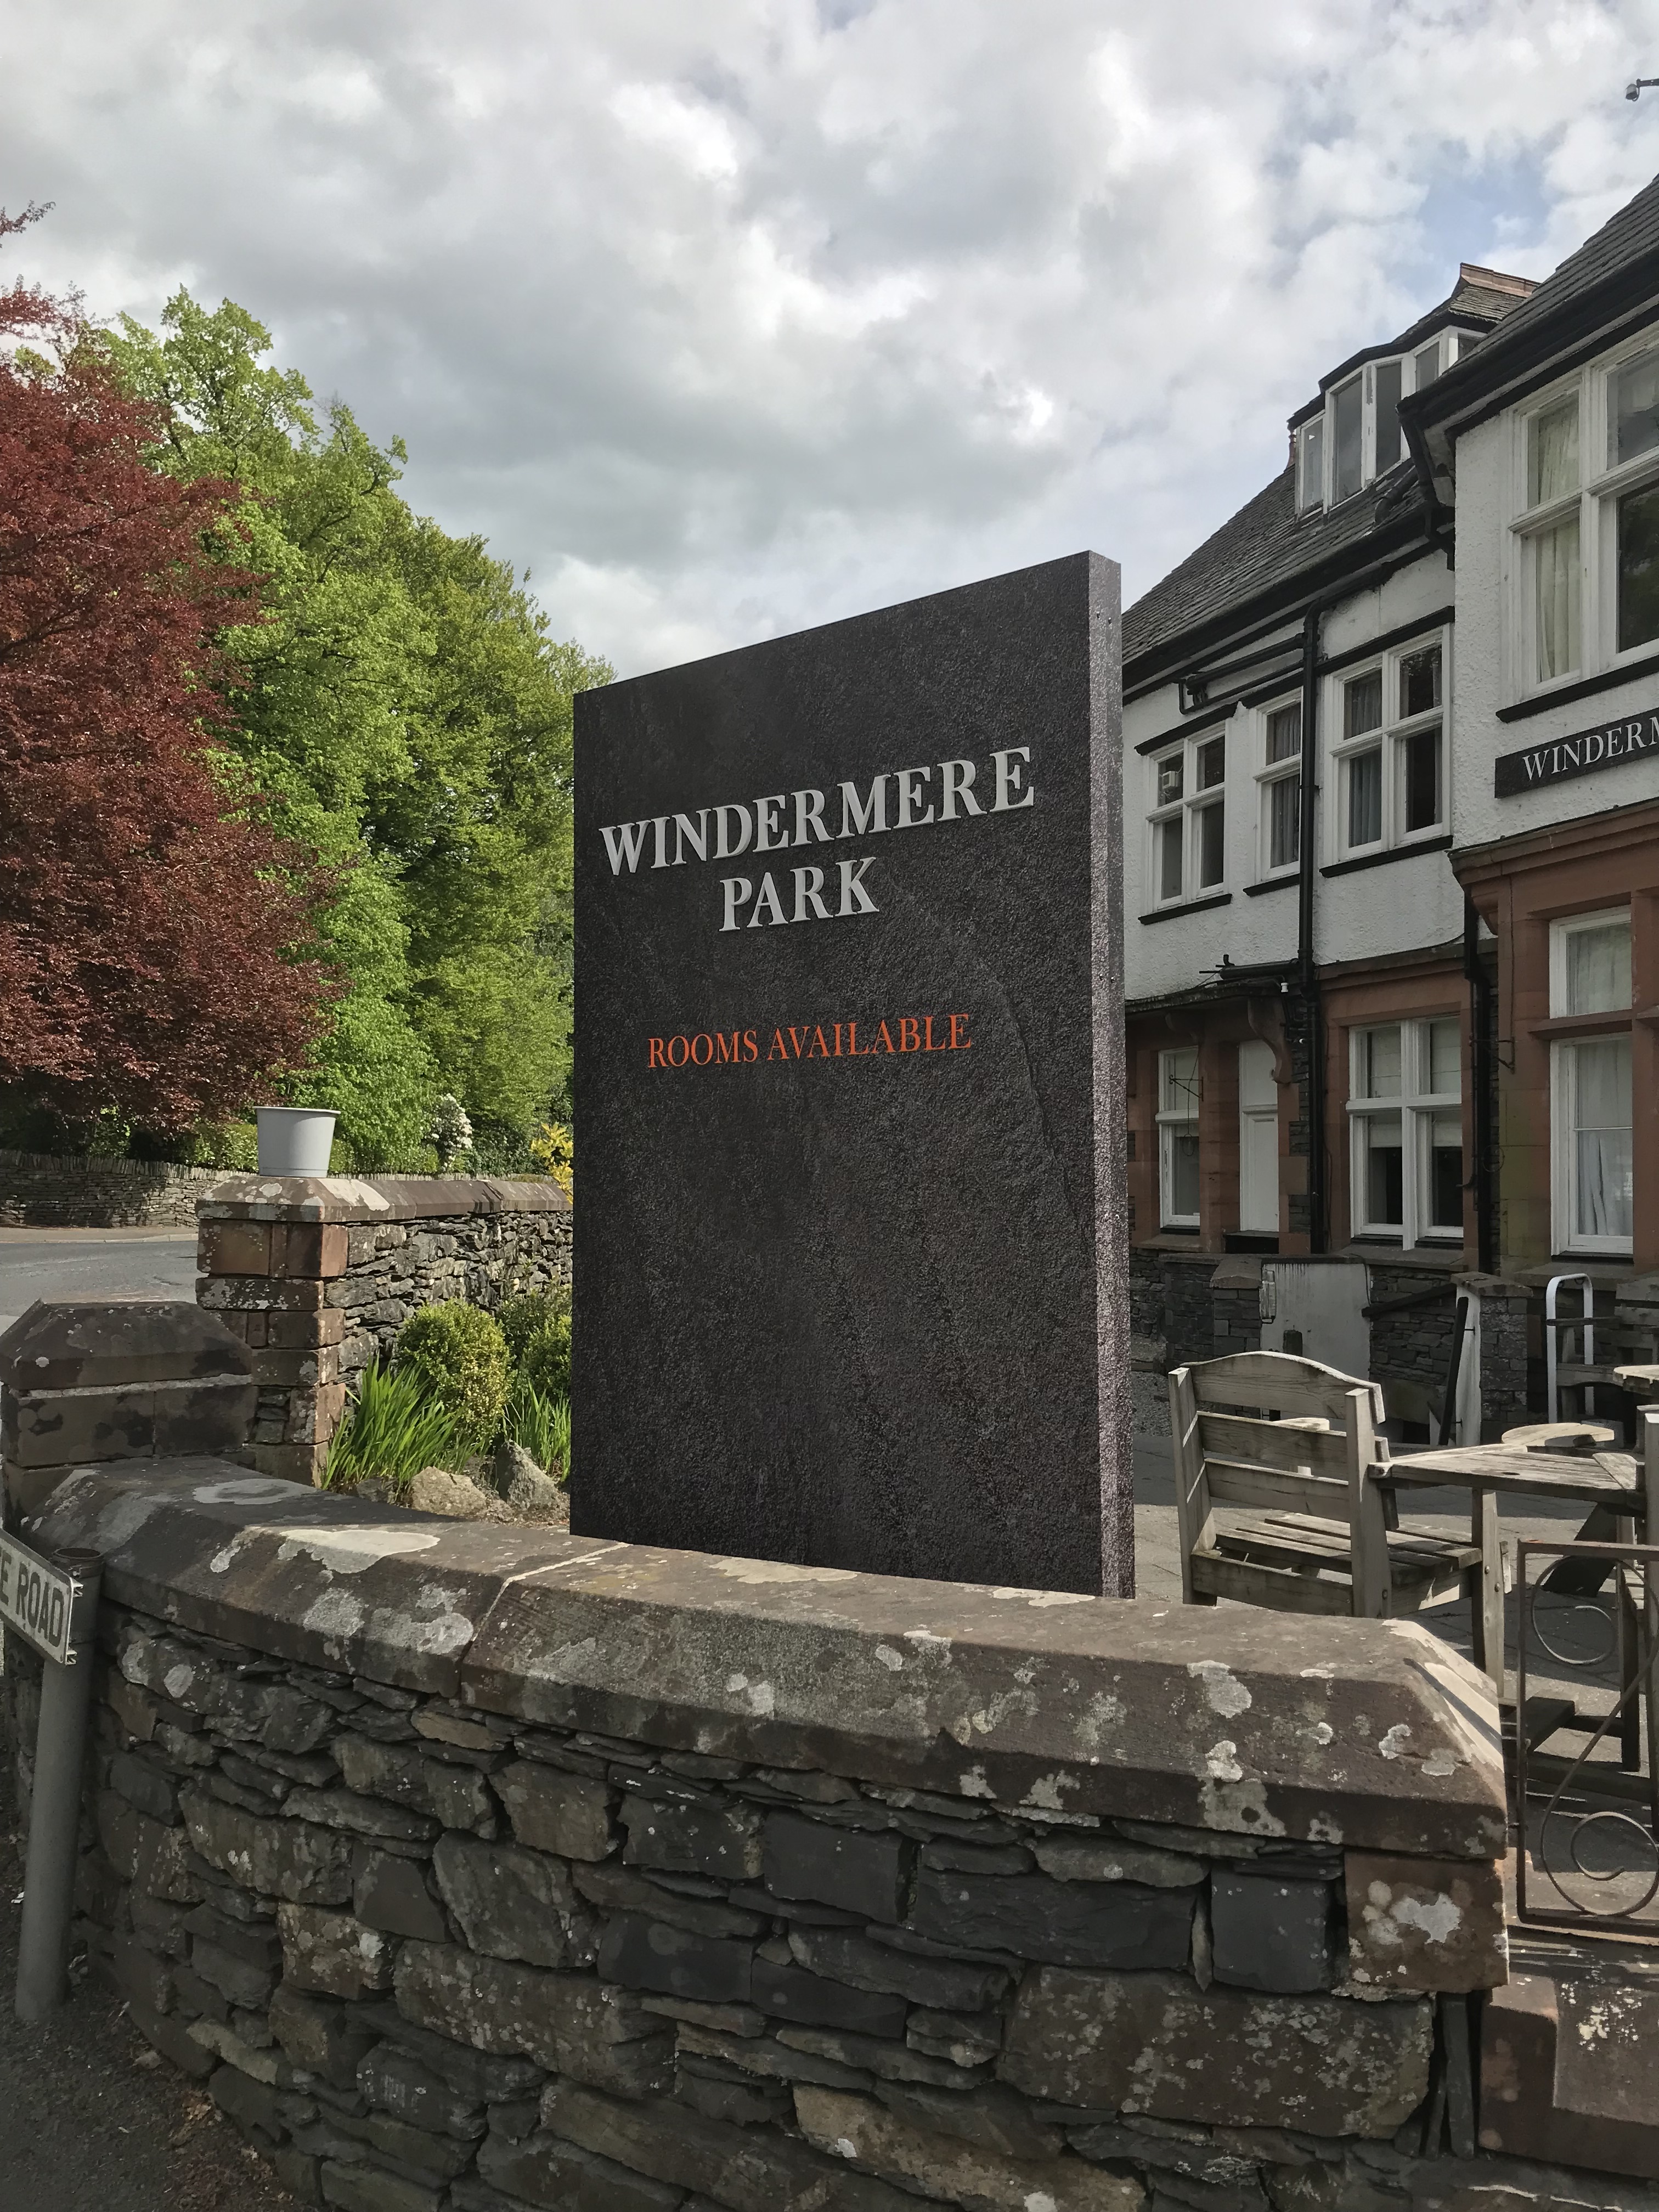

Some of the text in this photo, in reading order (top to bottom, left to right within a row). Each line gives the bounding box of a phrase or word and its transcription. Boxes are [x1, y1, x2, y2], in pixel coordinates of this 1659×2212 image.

[599, 747, 1035, 876] WINDERMERE
[719, 857, 879, 932] PARK
[648, 1014, 972, 1068] ROOMS AVAILABLE
[15, 1562, 65, 1647] ROAD
